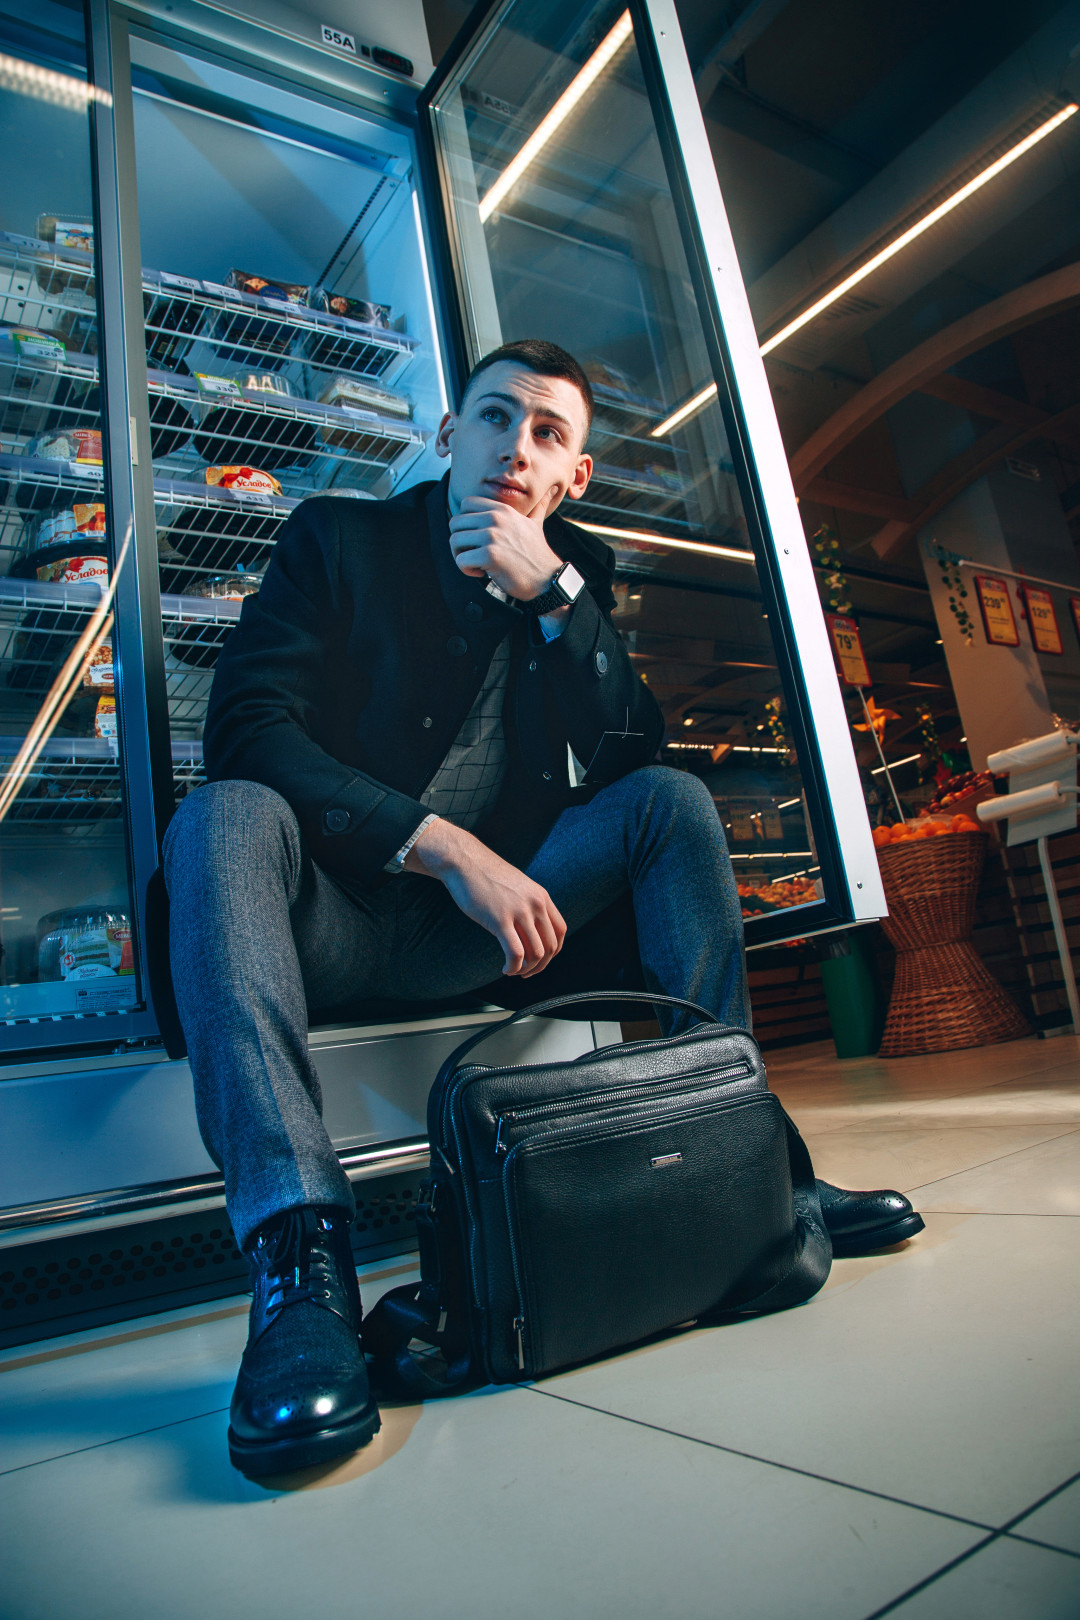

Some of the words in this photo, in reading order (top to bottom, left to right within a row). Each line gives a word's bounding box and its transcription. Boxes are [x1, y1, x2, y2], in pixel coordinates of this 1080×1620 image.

[324, 28, 355, 51] 55A
[236, 478, 272, 489] Усладов
[64, 567, 109, 583] Усладов
